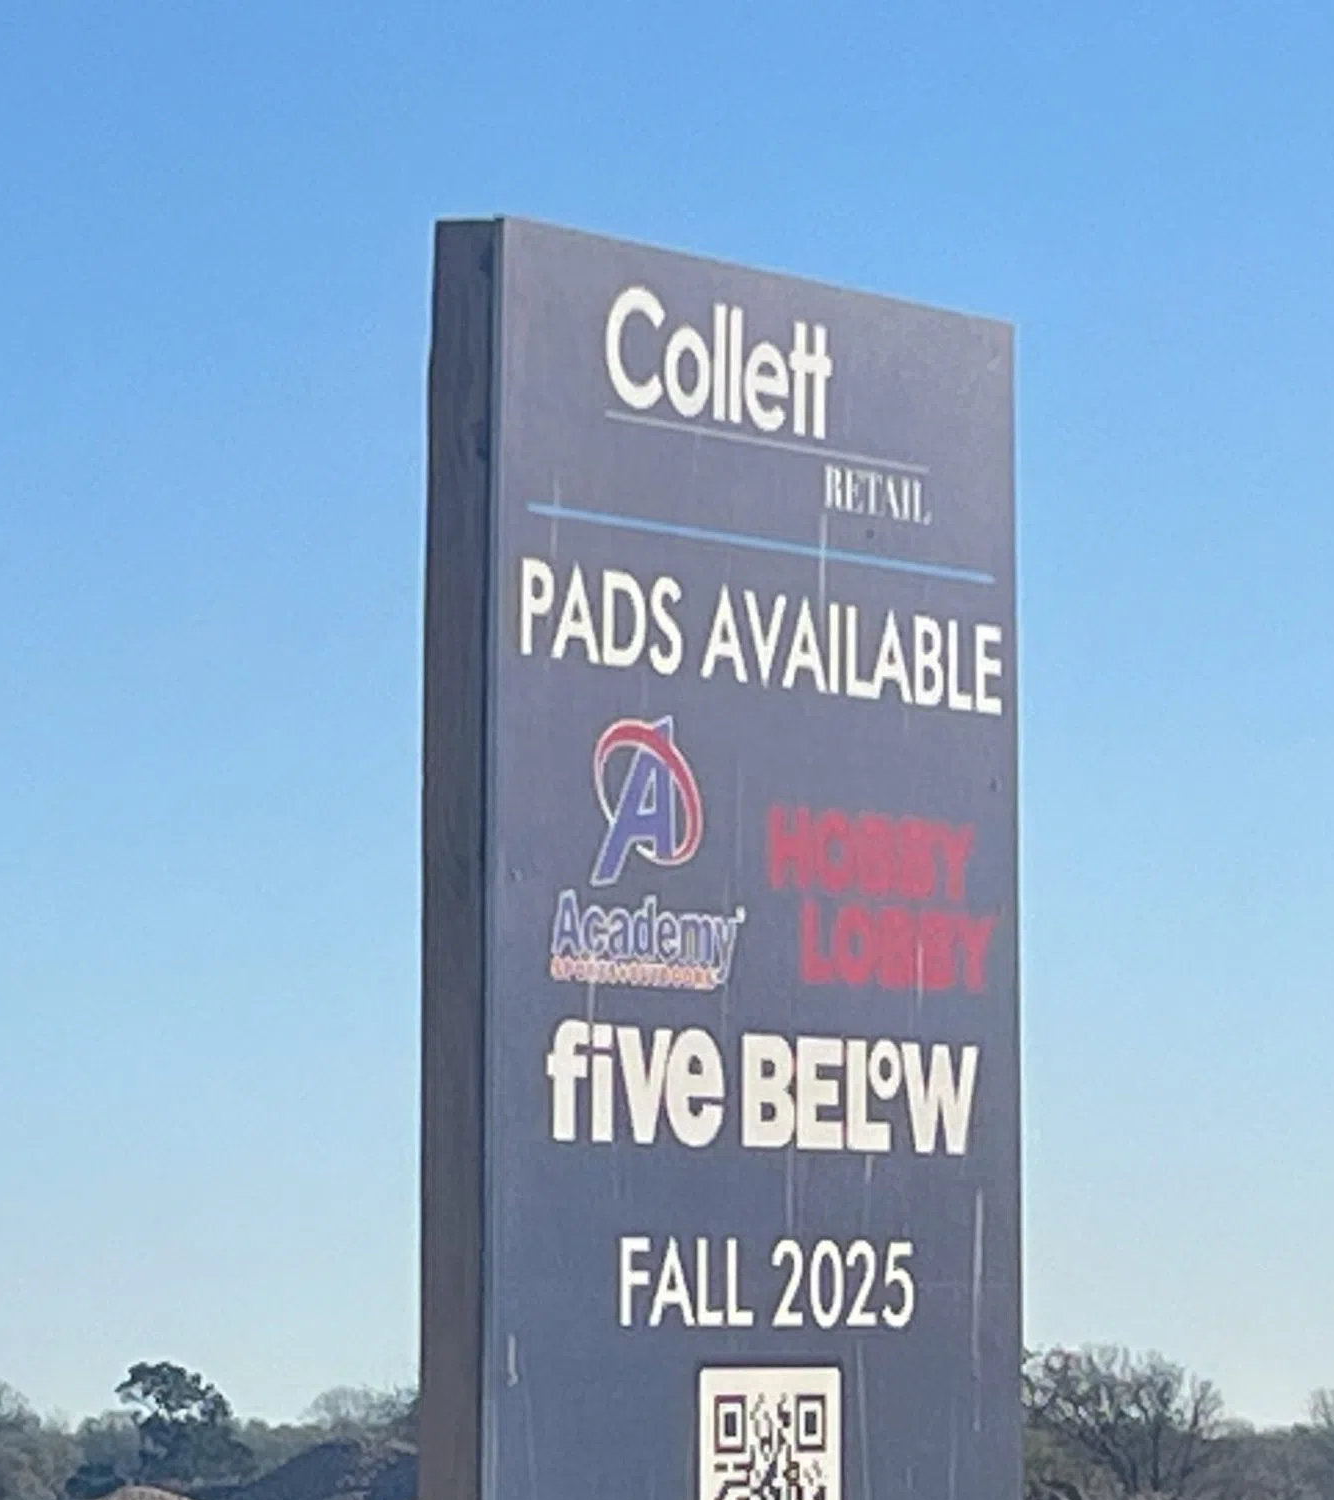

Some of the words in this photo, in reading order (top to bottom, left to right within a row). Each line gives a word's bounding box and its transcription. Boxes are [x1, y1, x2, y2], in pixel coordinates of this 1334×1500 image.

[605, 286, 834, 440] Collett
[824, 464, 931, 526] RETAIL
[520, 557, 683, 677] PADS
[700, 584, 1004, 716] AVAILABLE
[768, 805, 976, 901] HOBBY
[799, 899, 1002, 994] LOBBY
[546, 1019, 726, 1149] five
[740, 1033, 979, 1156] BELOW
[619, 1236, 754, 1327] FALL
[771, 1240, 916, 1328] 2025
